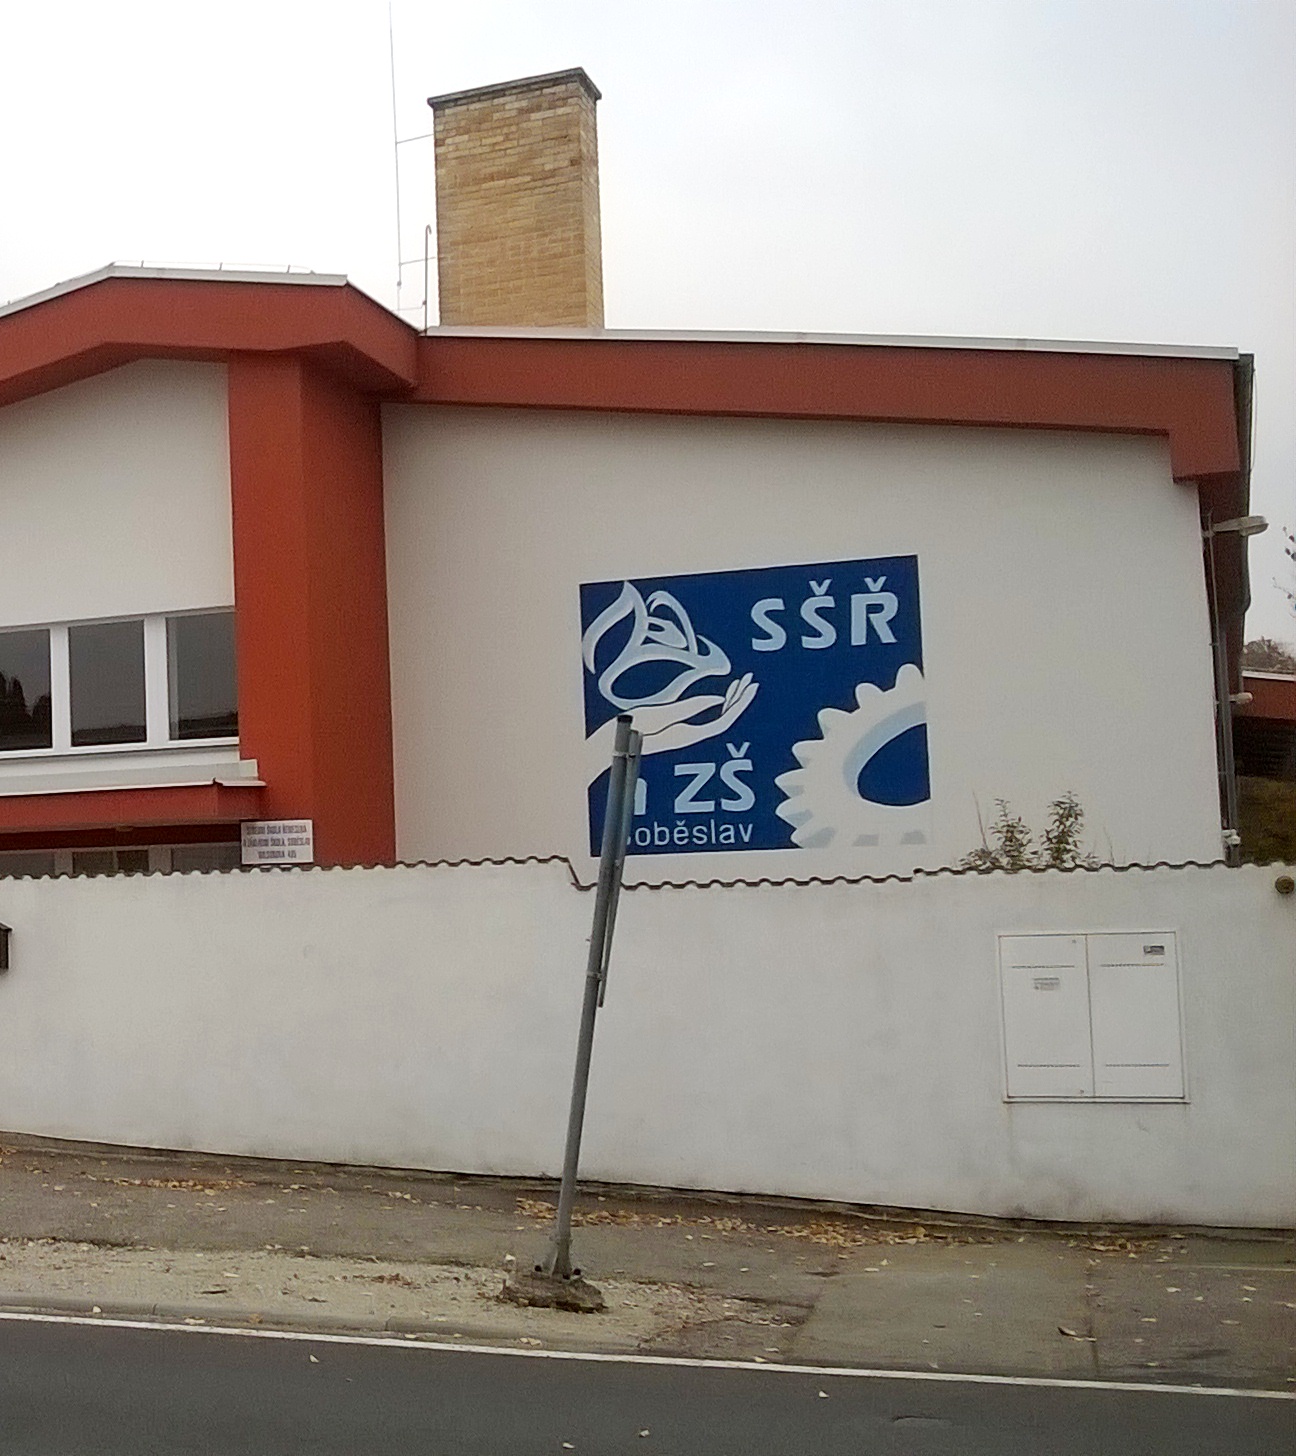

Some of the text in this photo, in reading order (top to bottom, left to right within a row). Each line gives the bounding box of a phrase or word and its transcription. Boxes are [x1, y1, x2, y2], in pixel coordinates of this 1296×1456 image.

[750, 575, 899, 651] SŠŘ
[674, 742, 755, 813] ZŠ
[626, 819, 753, 846] oběslav
